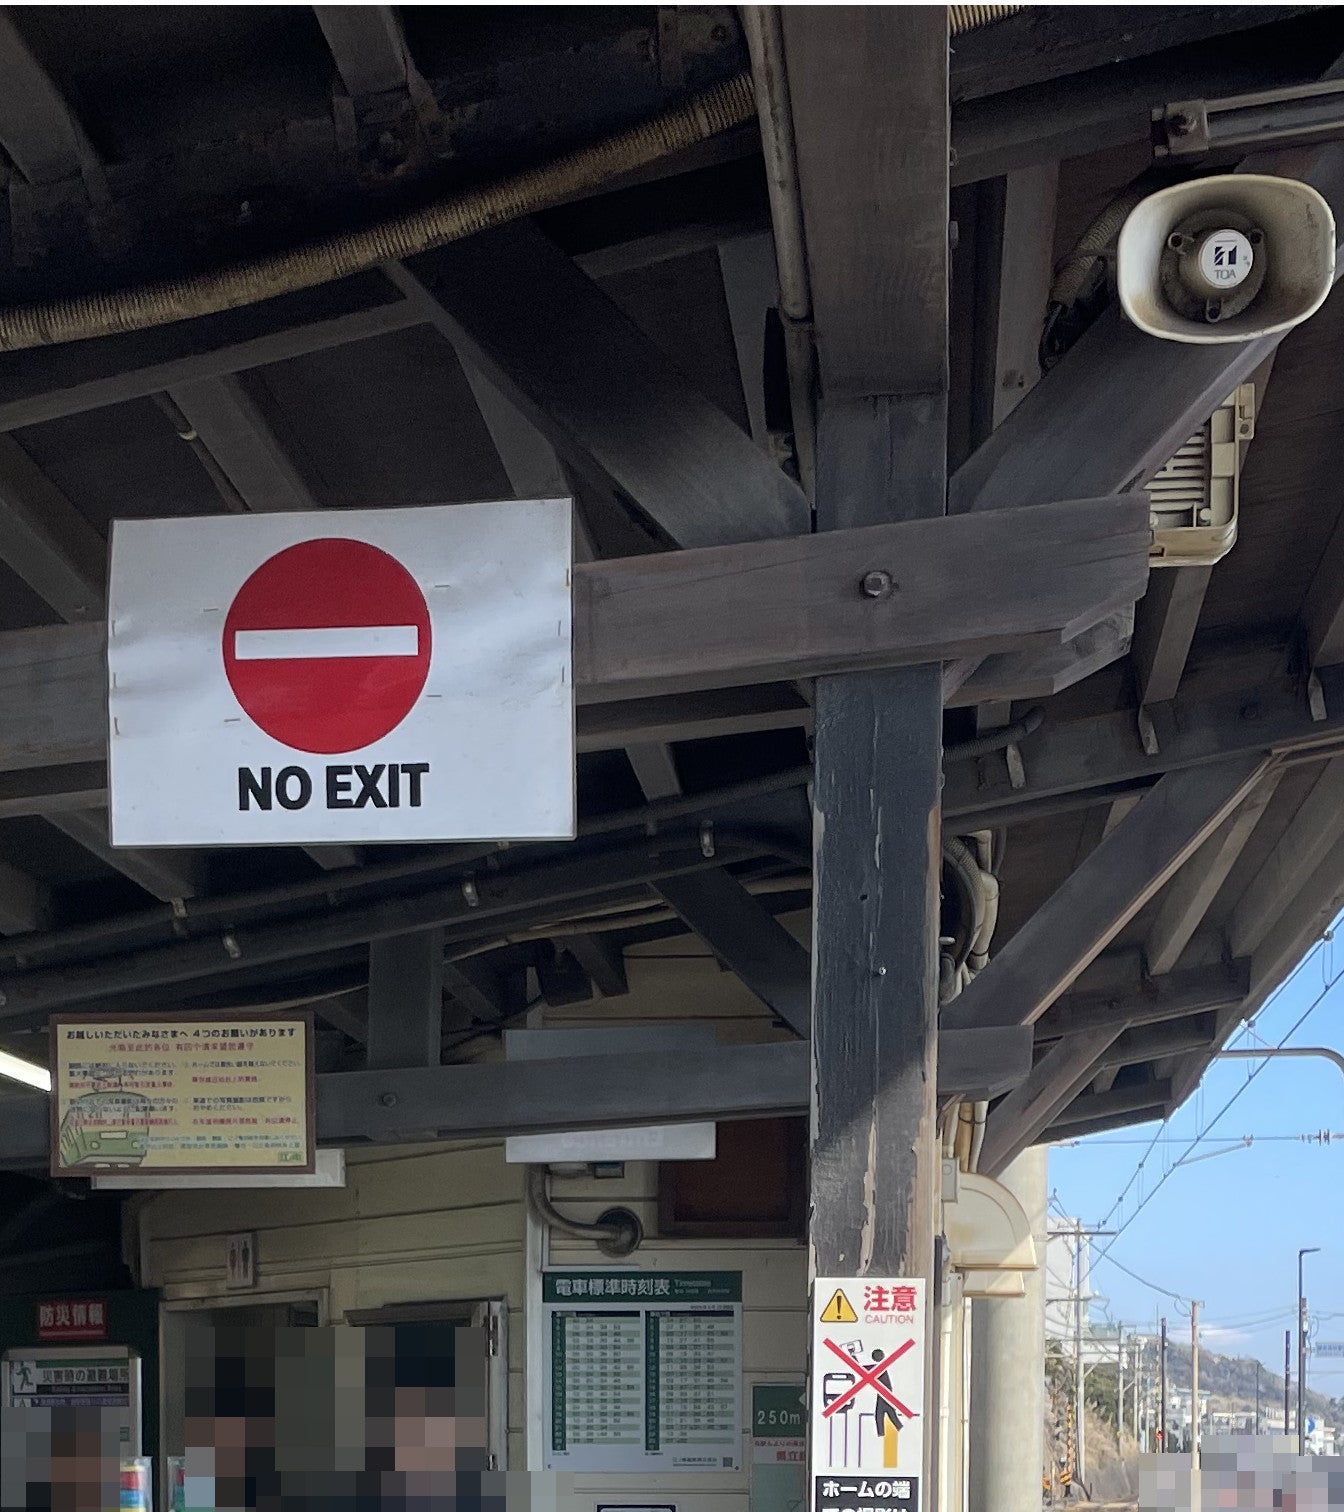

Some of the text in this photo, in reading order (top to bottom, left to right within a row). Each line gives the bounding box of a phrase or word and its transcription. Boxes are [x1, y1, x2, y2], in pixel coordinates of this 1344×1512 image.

[1214, 269, 1236, 279] TOA
[238, 762, 430, 811] NO EXIT
[556, 1278, 670, 1296] 電車標準時刻表
[864, 1285, 916, 1313] 注意
[39, 1303, 104, 1327] 防災情報
[865, 1314, 914, 1324] CAUTION
[757, 1410, 801, 1425] 250m
[822, 1480, 910, 1499] ホームの端
